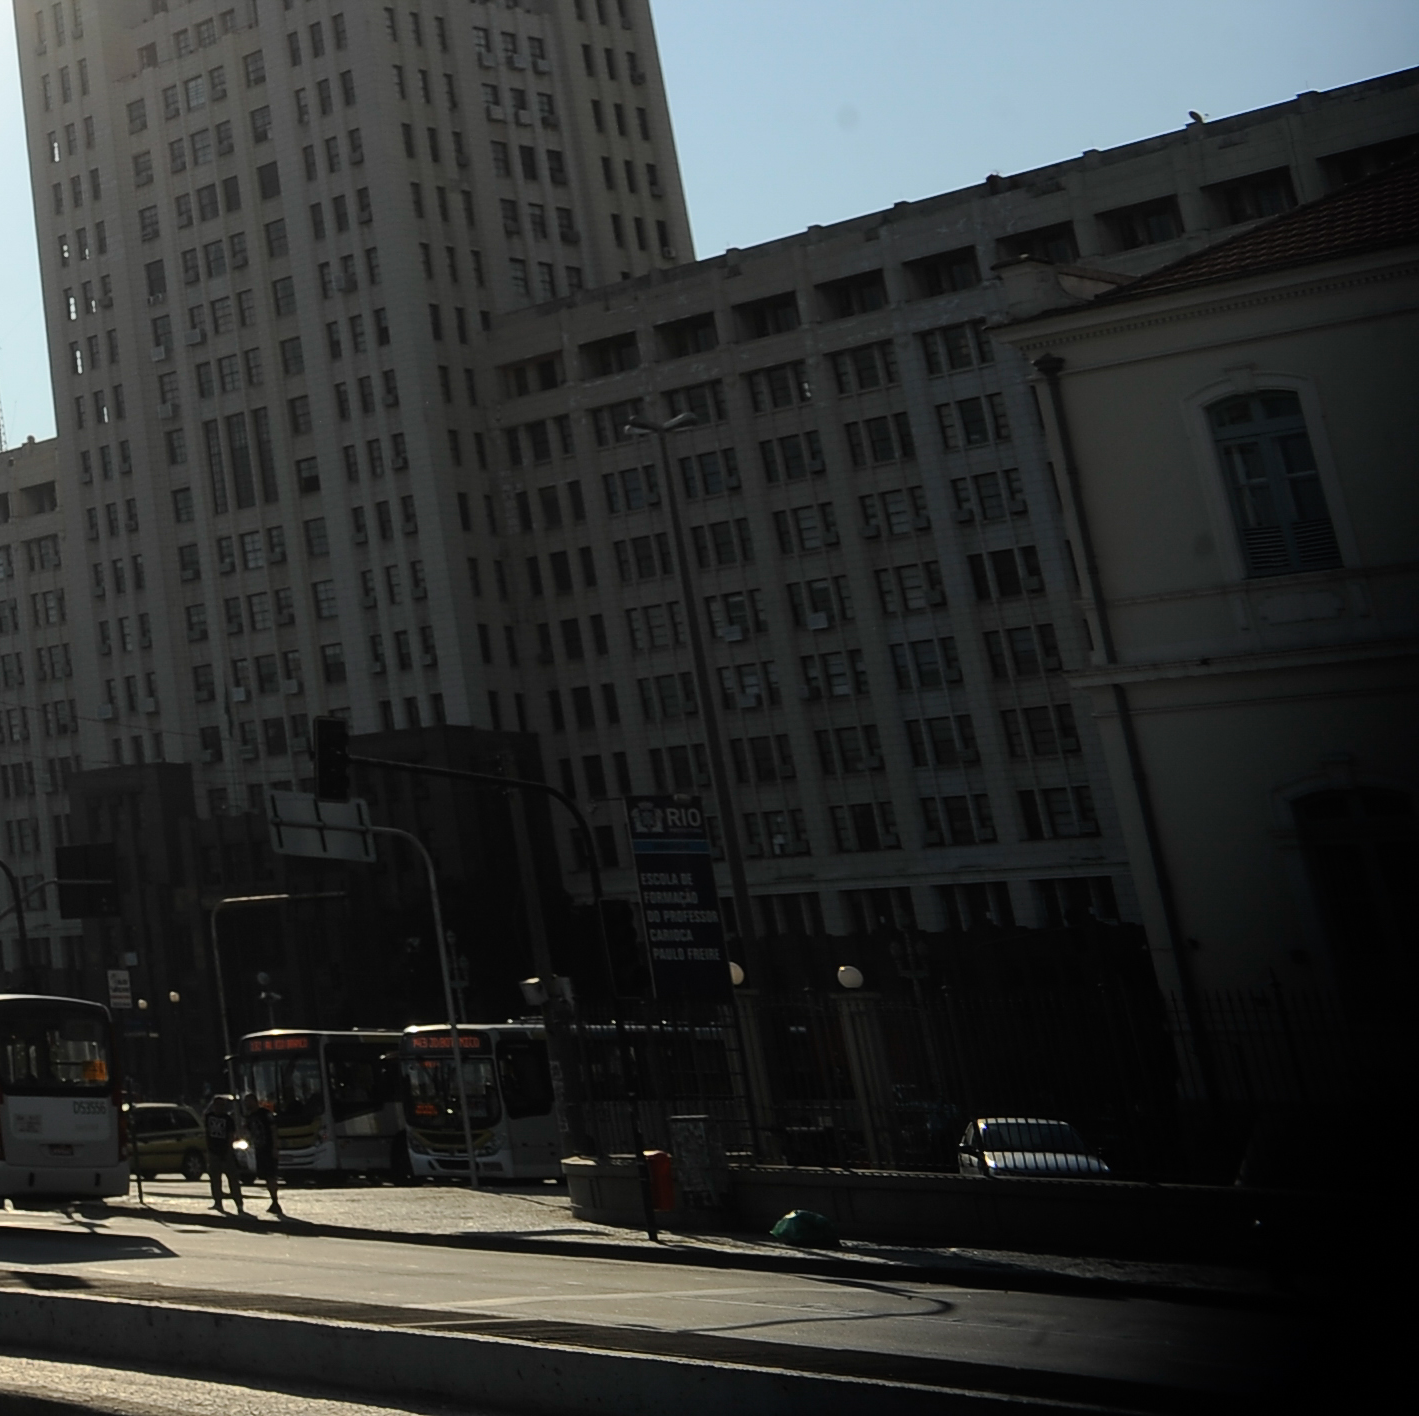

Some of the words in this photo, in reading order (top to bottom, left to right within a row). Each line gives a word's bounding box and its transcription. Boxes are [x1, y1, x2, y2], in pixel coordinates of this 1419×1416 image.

[665, 807, 703, 828] RIO
[640, 872, 680, 886] ESCOLA
[681, 872, 694, 886] DE
[643, 887, 699, 908] FORMAÇÃO
[646, 909, 661, 923] DO
[662, 909, 719, 923] PROFESSOR
[649, 928, 694, 942] CARIOCA
[652, 947, 685, 961] PAULO
[686, 947, 722, 961] FREIRE
